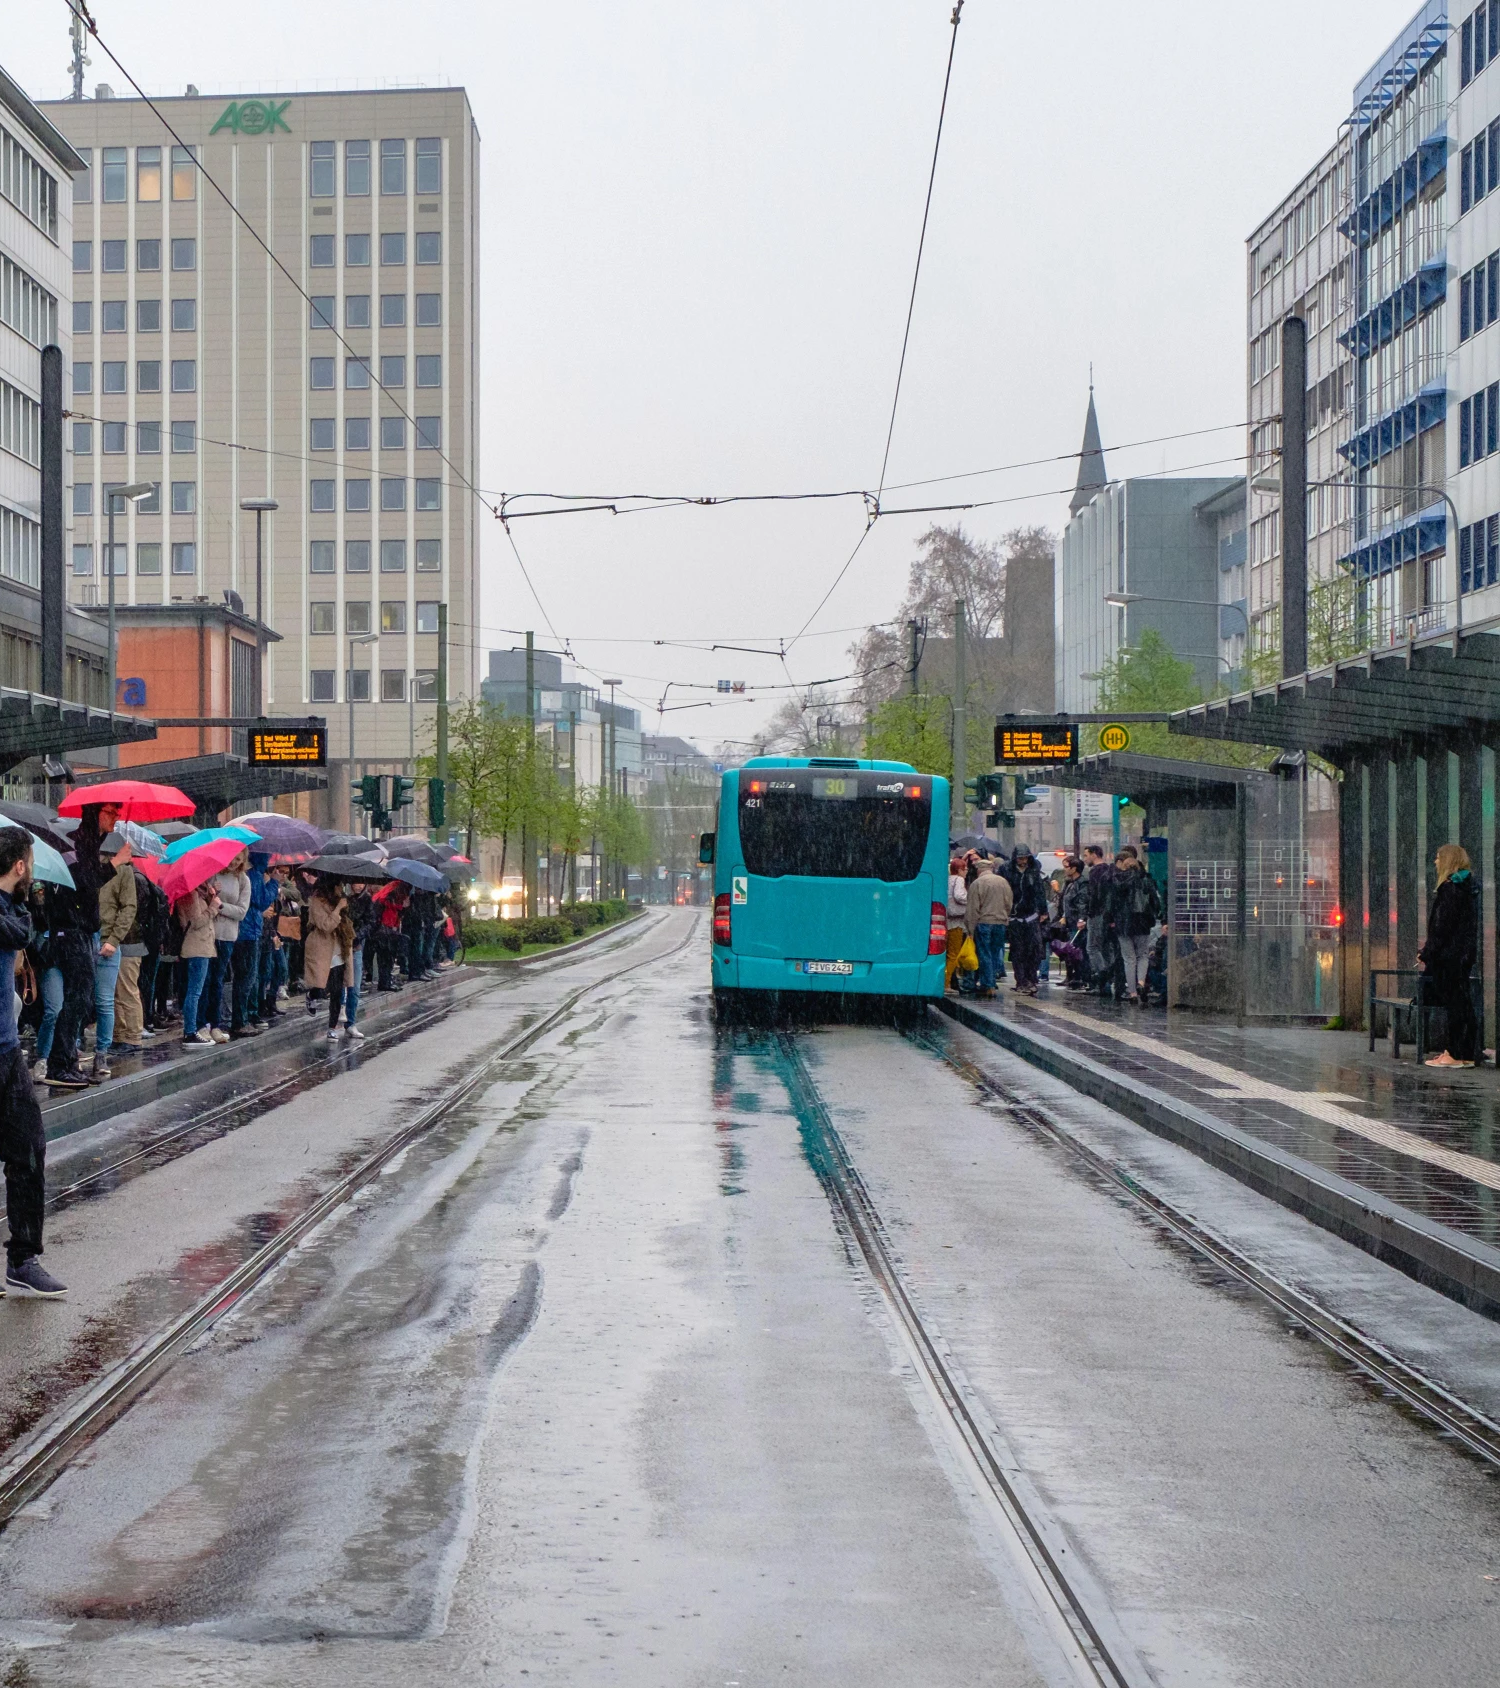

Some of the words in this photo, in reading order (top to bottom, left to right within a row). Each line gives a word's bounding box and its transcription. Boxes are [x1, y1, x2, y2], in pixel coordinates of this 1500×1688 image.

[209, 100, 292, 135] AOK
[826, 779, 845, 795] 30
[745, 799, 760, 808] 421
[831, 964, 851, 972] 2421
